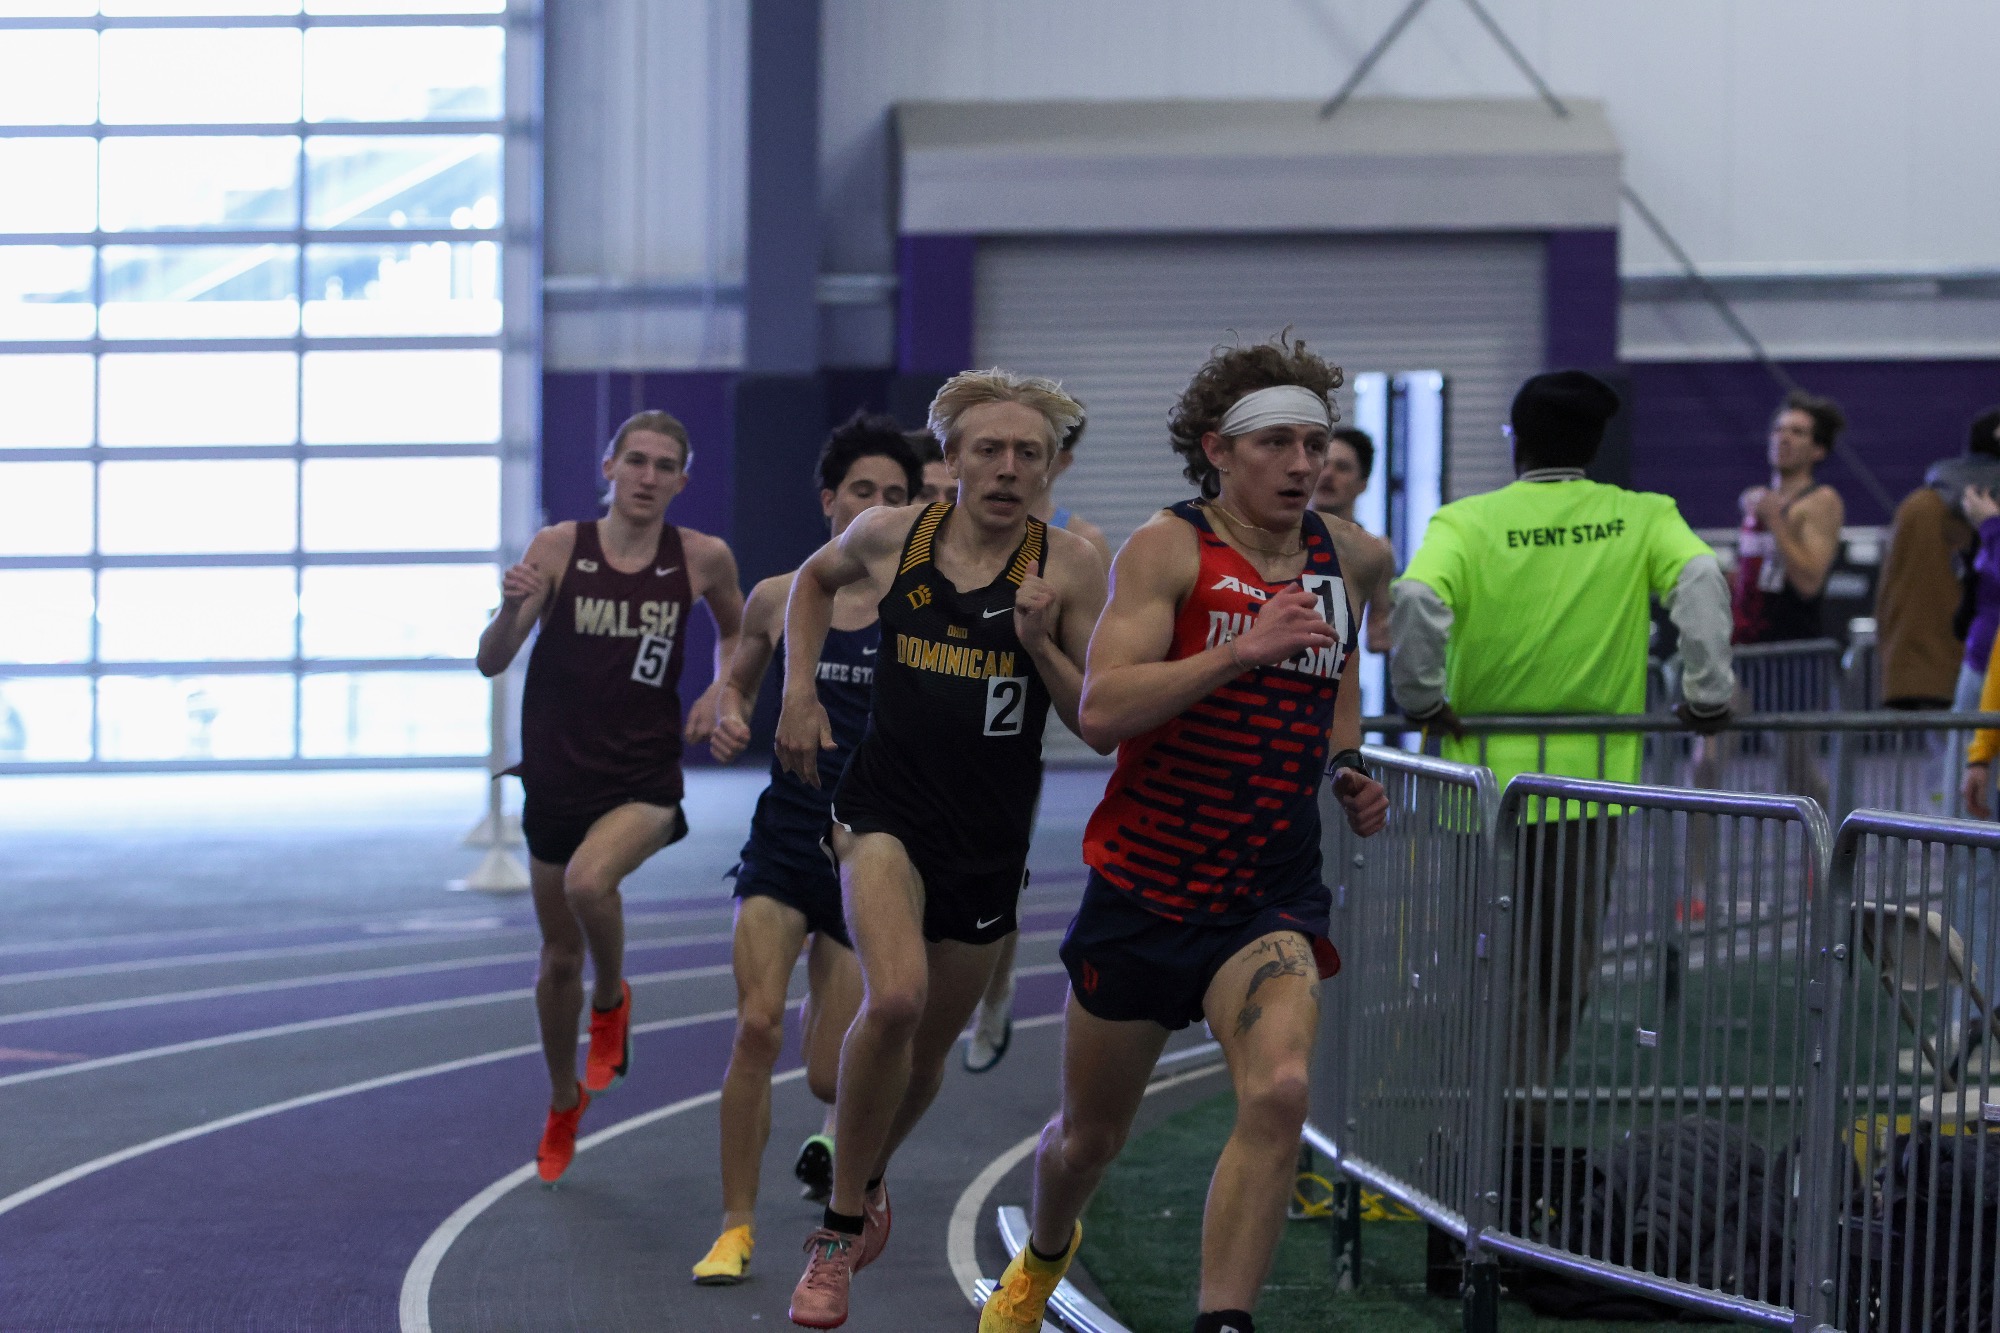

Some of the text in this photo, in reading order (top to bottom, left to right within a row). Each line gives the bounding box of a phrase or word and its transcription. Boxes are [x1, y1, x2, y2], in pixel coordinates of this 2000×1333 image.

[1507, 519, 1625, 548] EVENT STAFF
[574, 596, 680, 638] WALSH
[1311, 580, 1336, 627] 1
[946, 624, 968, 640] OHIO
[638, 639, 667, 670] 5
[897, 633, 1015, 680] DOMINICAN
[989, 680, 1022, 732] 2
